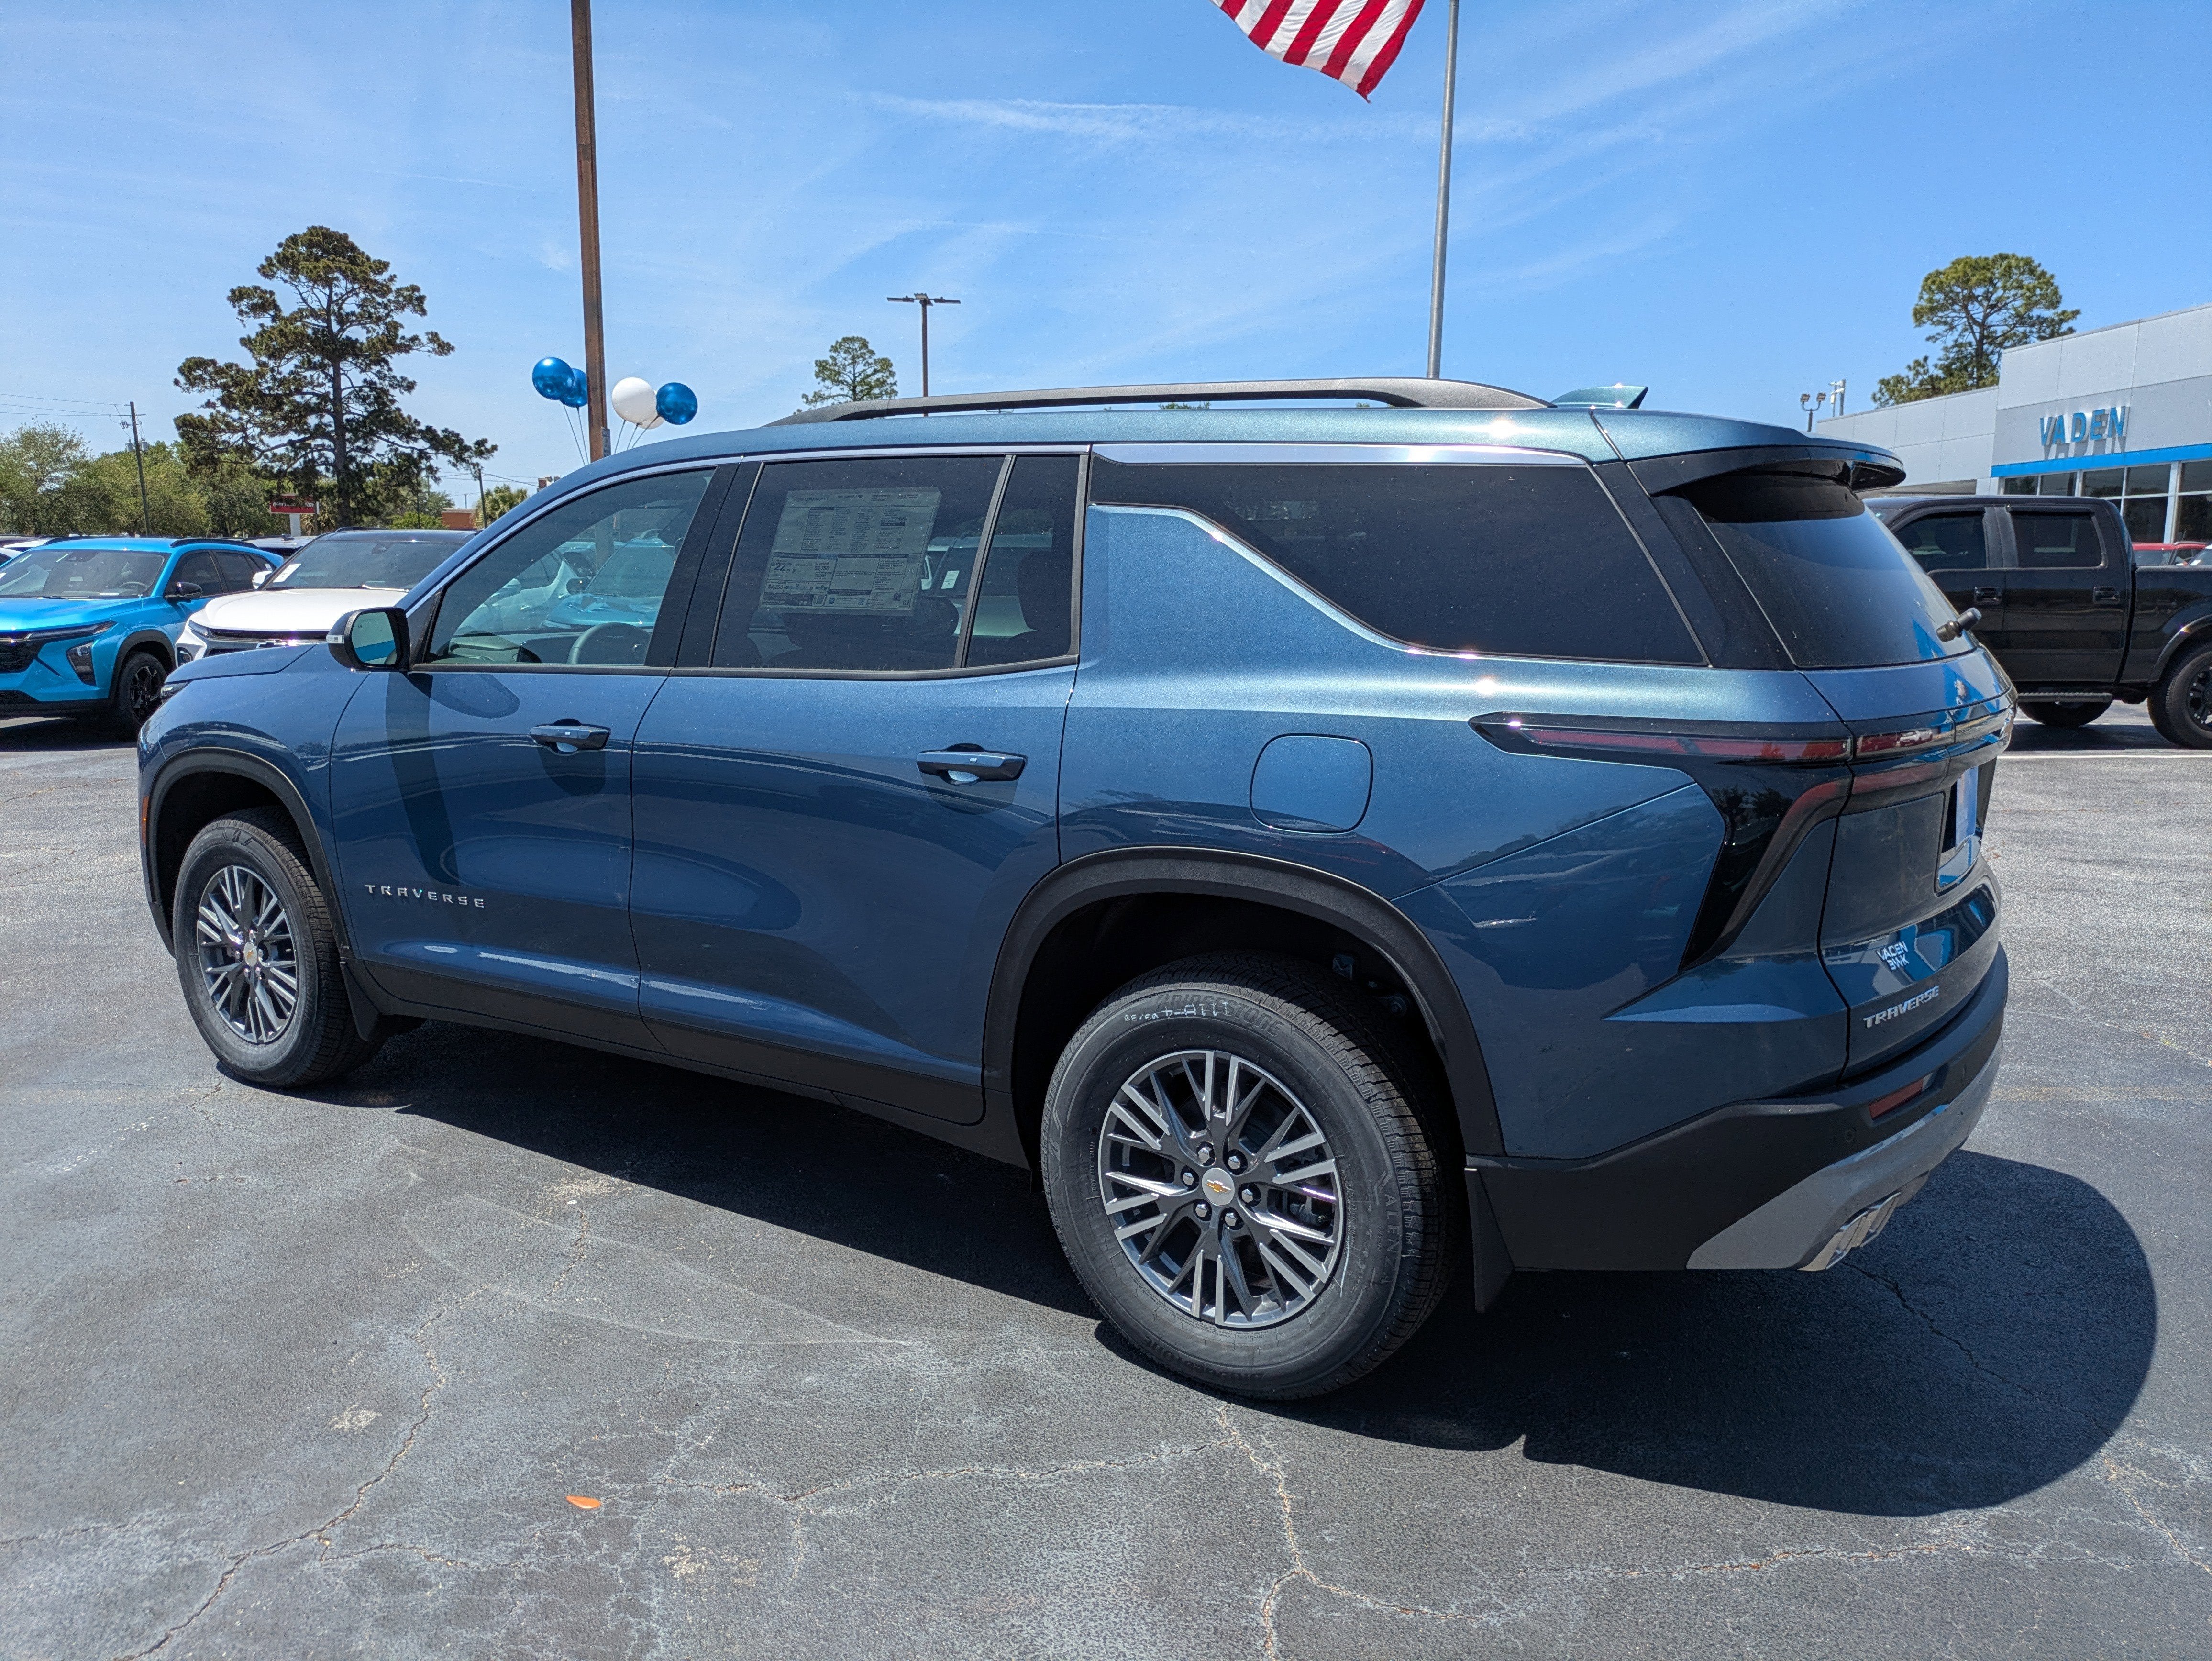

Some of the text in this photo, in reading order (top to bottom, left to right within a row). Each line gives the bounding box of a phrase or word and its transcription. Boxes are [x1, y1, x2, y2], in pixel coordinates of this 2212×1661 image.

[2040, 406, 2125, 446] VADEN
[774, 562, 786, 571] 22
[365, 885, 484, 908] TRAVERSE
[1876, 941, 1908, 960] VADEN
[1157, 993, 1285, 1037] BRIDGESTONE
[1863, 985, 1939, 1028] TRAVERSE
[1380, 1194, 1400, 1283] ALENZA
